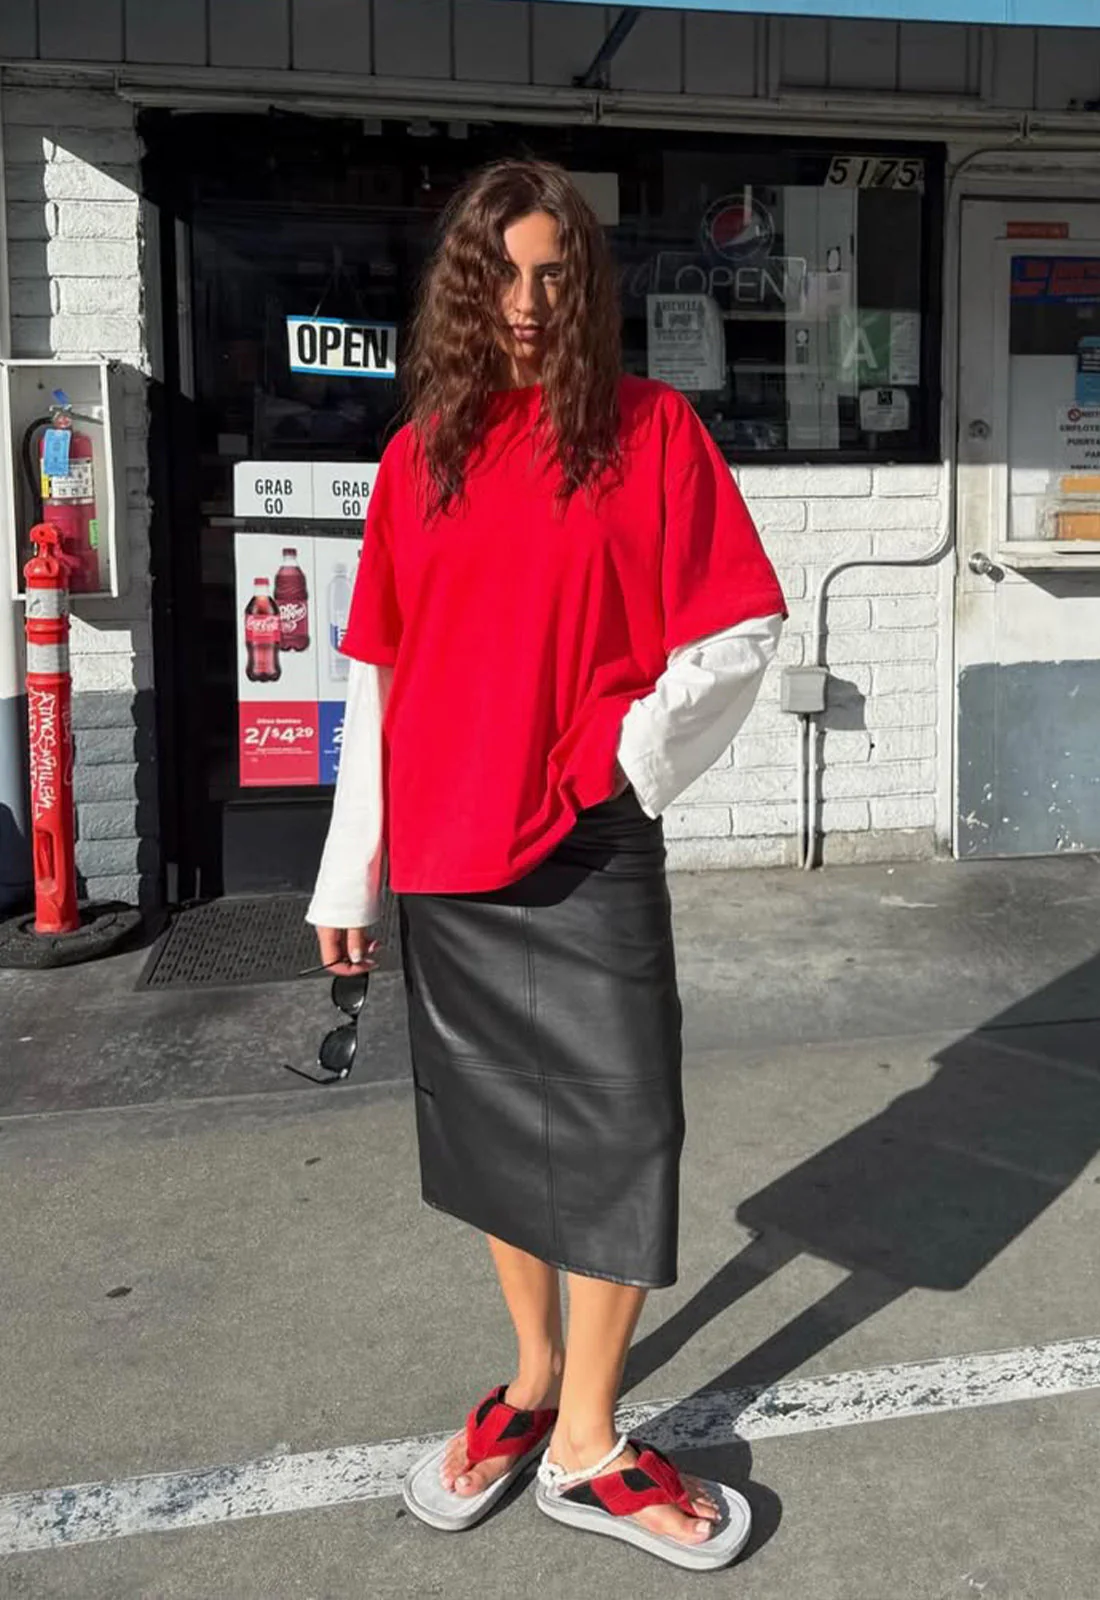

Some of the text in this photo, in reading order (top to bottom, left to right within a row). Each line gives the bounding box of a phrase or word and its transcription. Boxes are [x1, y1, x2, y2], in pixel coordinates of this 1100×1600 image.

[829, 158, 920, 187] 5175
[676, 267, 787, 302] OPEN
[296, 323, 389, 369] OPEN
[841, 327, 878, 369] A
[255, 479, 293, 496] GRAB
[332, 480, 370, 498] GRAB
[264, 498, 284, 515] GO
[342, 500, 361, 516] GO
